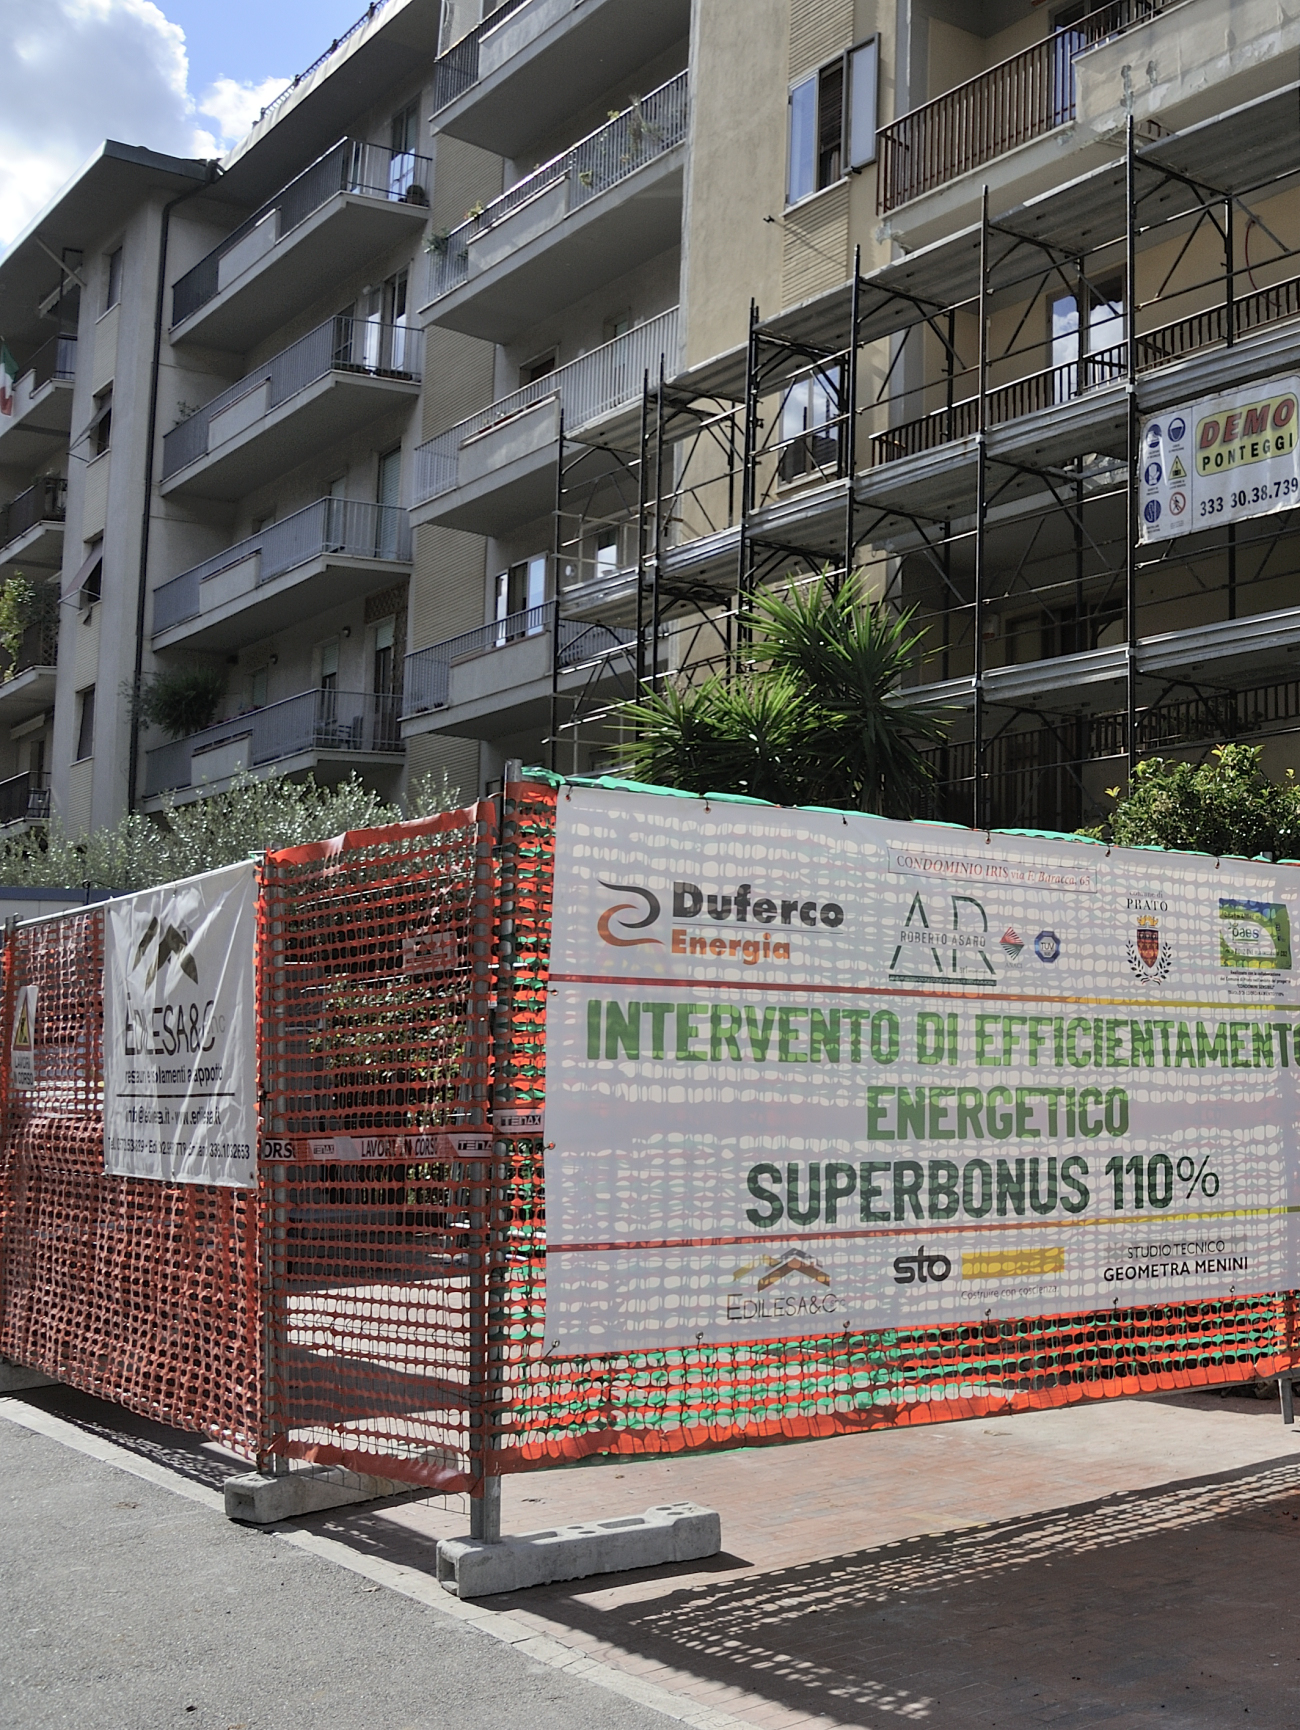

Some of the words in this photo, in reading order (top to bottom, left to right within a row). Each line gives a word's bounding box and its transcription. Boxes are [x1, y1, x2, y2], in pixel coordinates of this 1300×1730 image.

[1200, 398, 1295, 450] DEMO
[1202, 432, 1293, 471] PONTEGGI
[1200, 497, 1224, 517] 333
[1231, 476, 1299, 508] 30.38.739
[897, 855, 983, 876] CONDOMINIO
[985, 864, 1008, 878] IRIS
[1011, 869, 1024, 881] via
[1079, 875, 1091, 886] 65
[672, 881, 844, 928] Duferco
[1127, 898, 1168, 912] PRATO
[671, 929, 790, 966] Energia
[901, 931, 947, 945] ROBERTO
[952, 935, 986, 947] ASARO
[587, 999, 901, 1065] INTERVENTO
[917, 1011, 959, 1066] DI
[501, 1115, 541, 1126] TENAX
[866, 1085, 1130, 1140] ENERGETICO
[264, 1141, 297, 1159] ORS
[458, 1140, 493, 1151] TENA
[746, 1155, 1090, 1228] SUPERBONUS
[1105, 1152, 1220, 1211] 110%
[893, 1245, 951, 1284] sto
[1127, 1244, 1171, 1259] STUDIO
[1173, 1240, 1225, 1255] TECNICO
[1104, 1261, 1190, 1282] GEOMETRA
[1195, 1257, 1248, 1274] MENINI
[961, 1289, 999, 1300] Costruire
[1001, 1288, 1017, 1298] con
